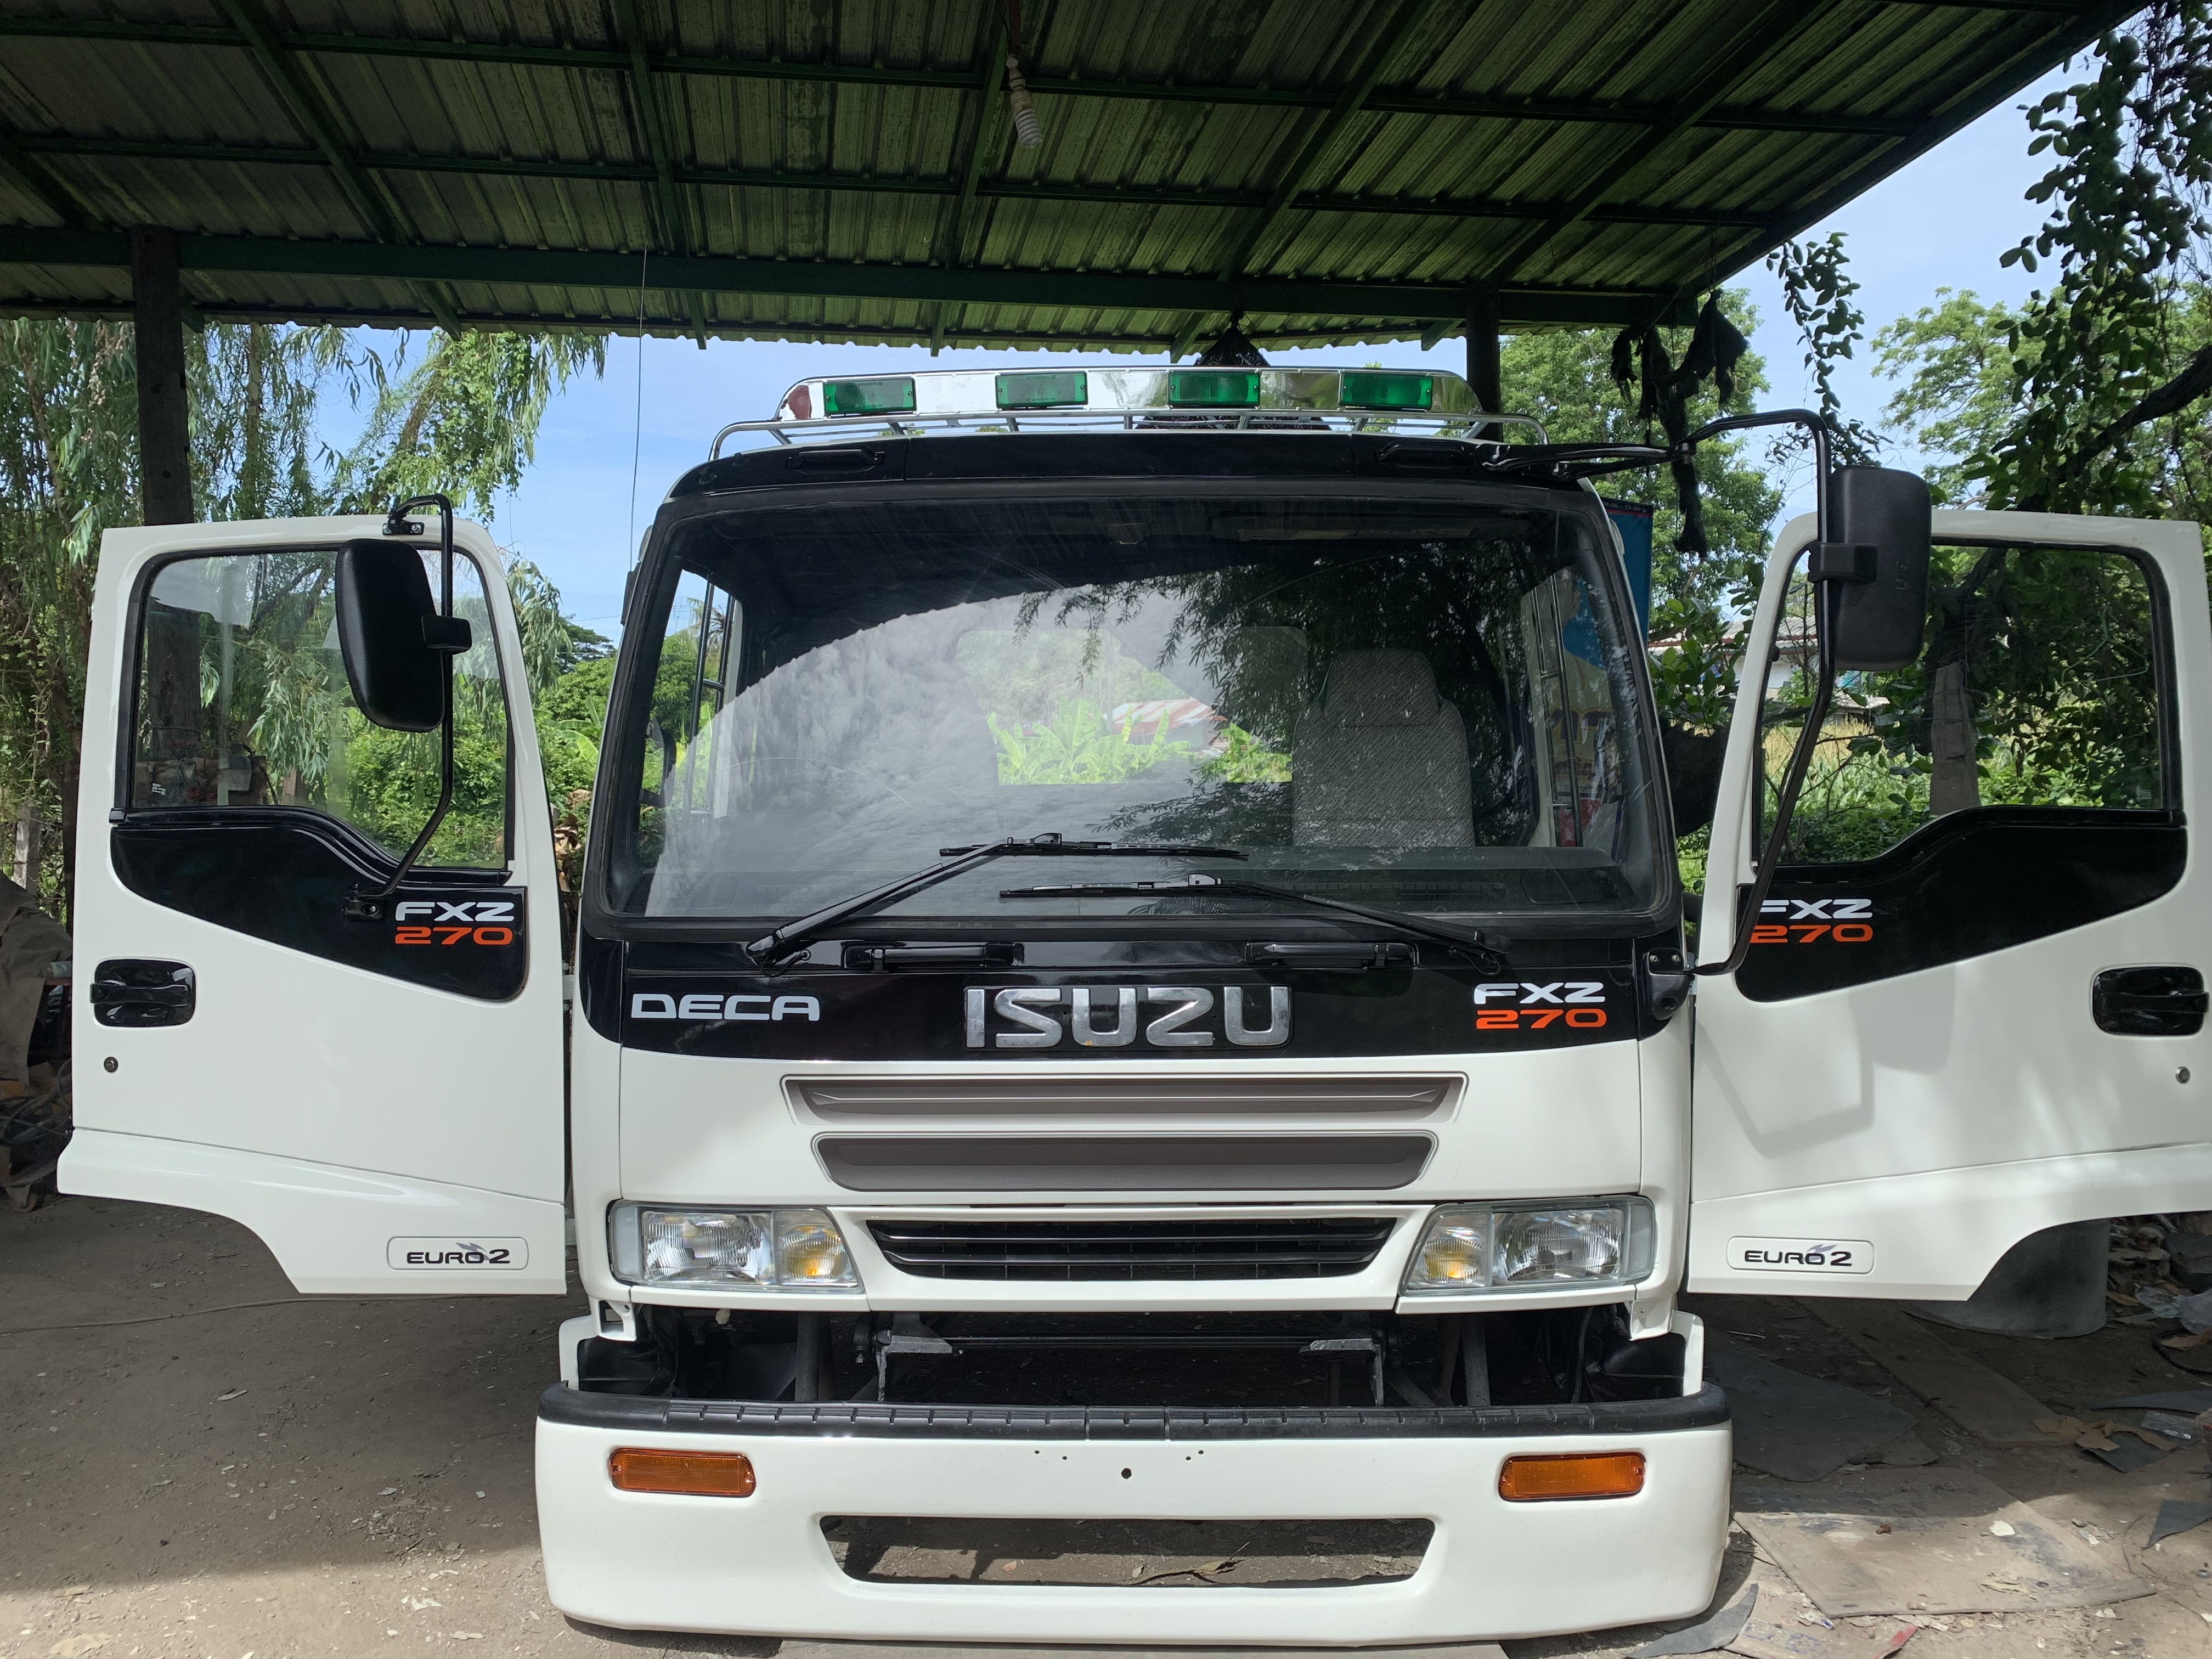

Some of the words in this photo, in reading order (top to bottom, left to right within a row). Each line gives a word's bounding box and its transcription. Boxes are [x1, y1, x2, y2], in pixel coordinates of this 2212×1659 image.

[395, 901, 515, 922] FXZ
[394, 927, 514, 945] 270
[1750, 924, 1874, 944] 270
[1474, 982, 1606, 1005] FXZ
[631, 994, 820, 1022] DECA
[966, 986, 1289, 1048] ISUZU
[1475, 1008, 1607, 1030] 270
